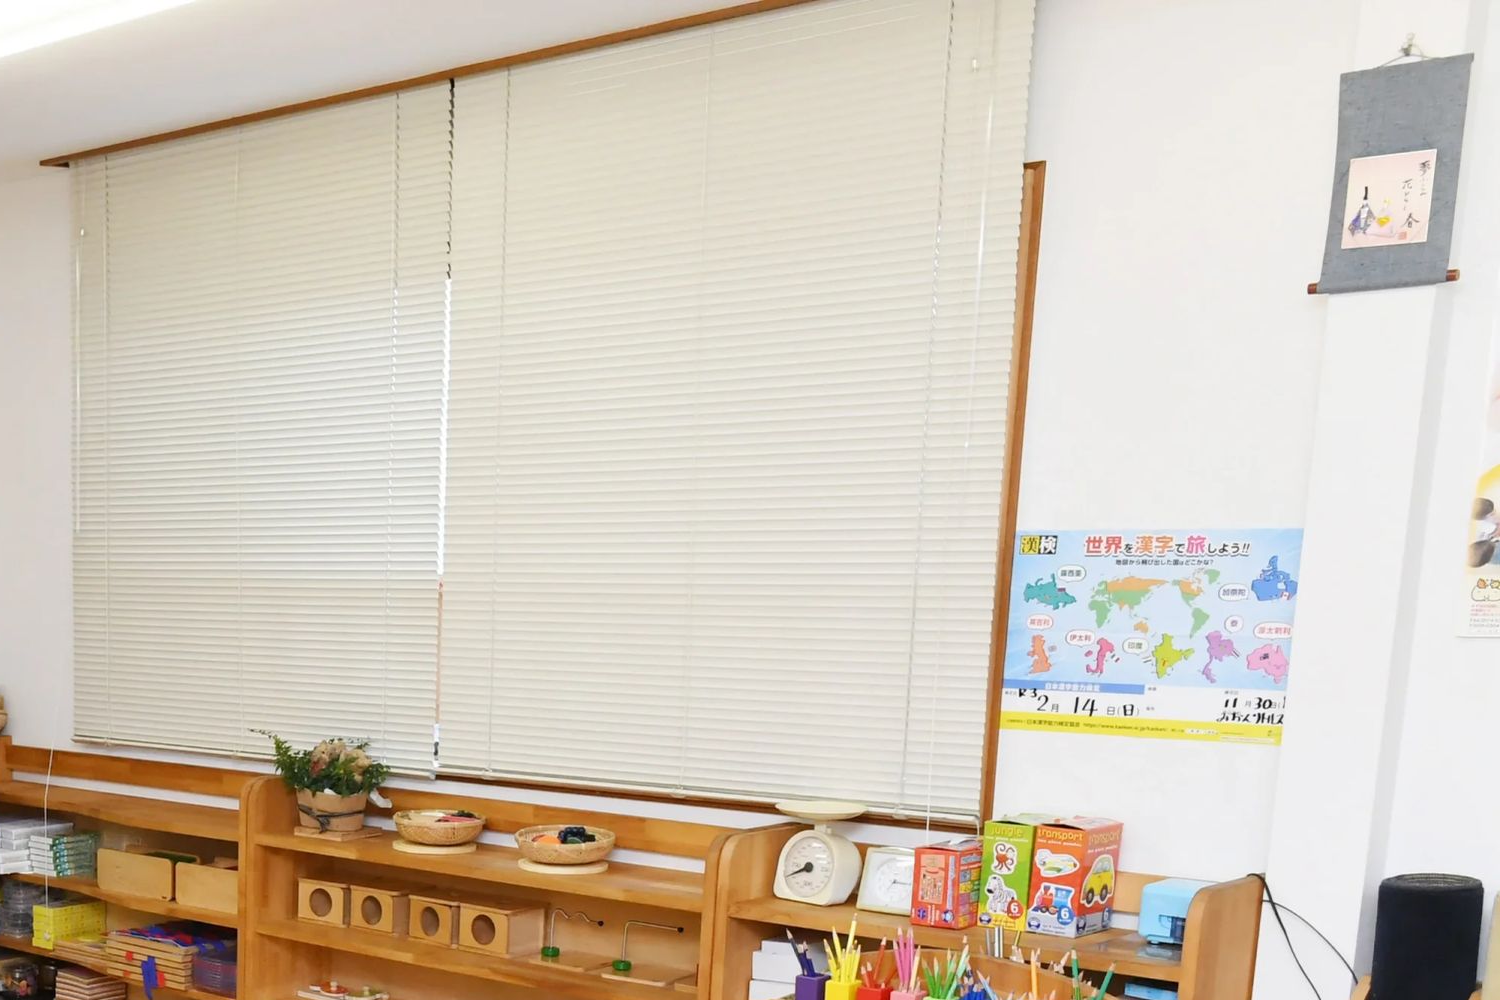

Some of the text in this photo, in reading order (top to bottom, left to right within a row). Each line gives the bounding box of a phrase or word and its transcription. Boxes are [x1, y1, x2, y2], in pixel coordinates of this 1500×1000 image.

[1020, 535, 1058, 555] 漢検
[1038, 829, 1084, 842] transport
[1060, 907, 1069, 919] 6
